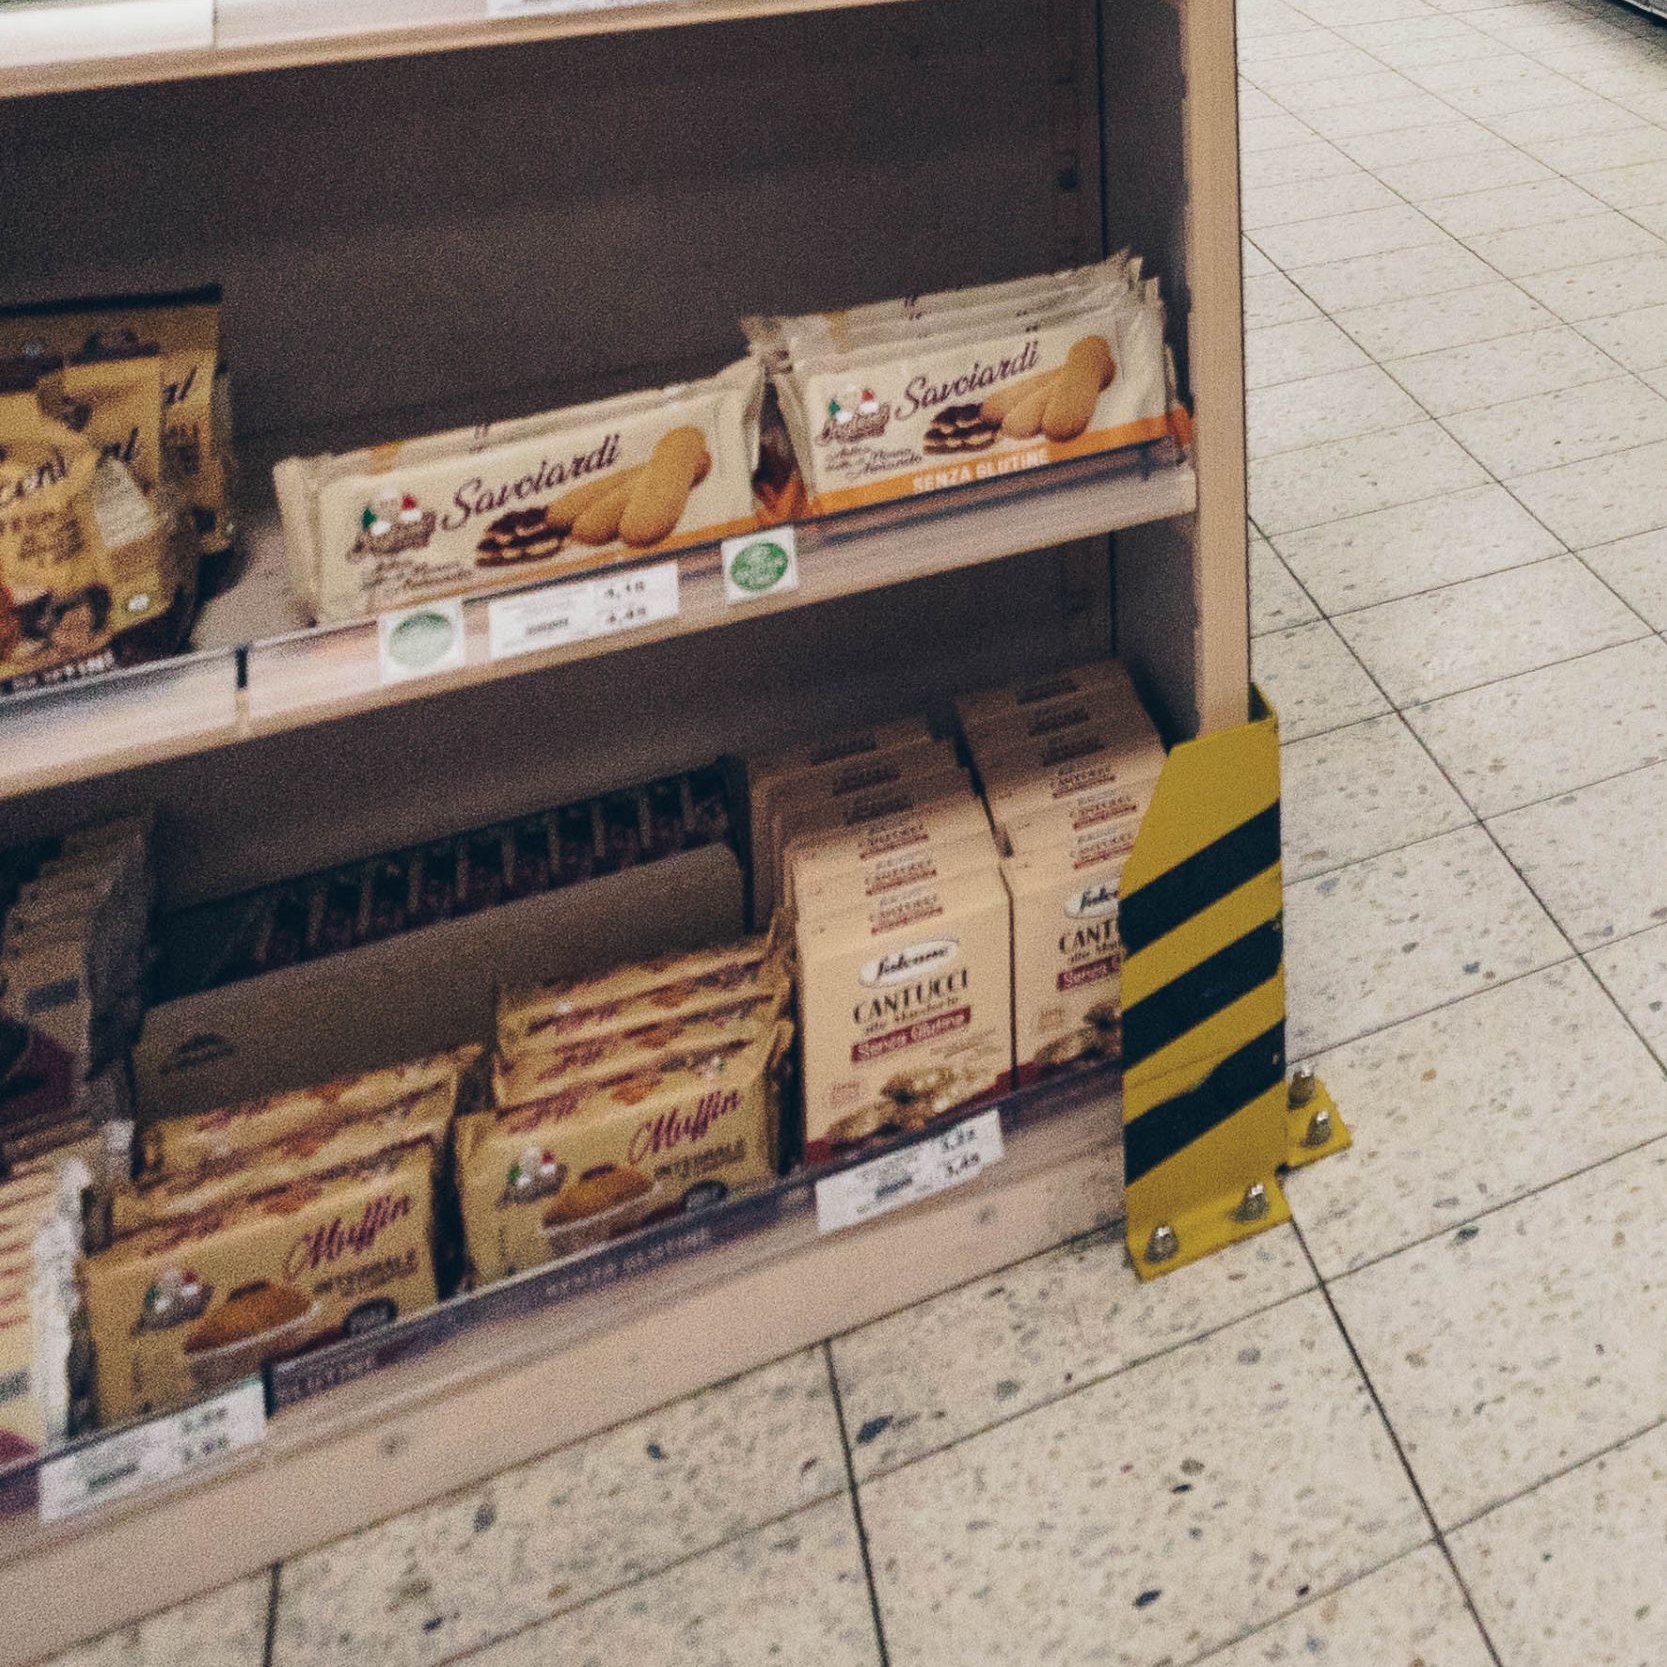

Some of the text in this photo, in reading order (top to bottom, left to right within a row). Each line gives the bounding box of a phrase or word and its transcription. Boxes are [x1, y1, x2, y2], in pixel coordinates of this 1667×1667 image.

[896, 341, 1041, 420] Savoiardi
[440, 435, 623, 532] Savoiardi
[912, 465, 972, 492] SENZA
[1058, 917, 1110, 956] CANT
[853, 969, 970, 1025] CANTUCCI
[858, 1014, 965, 1060] Senza Glutine
[628, 1089, 741, 1162] Muffin
[284, 1194, 414, 1278] Muffin
